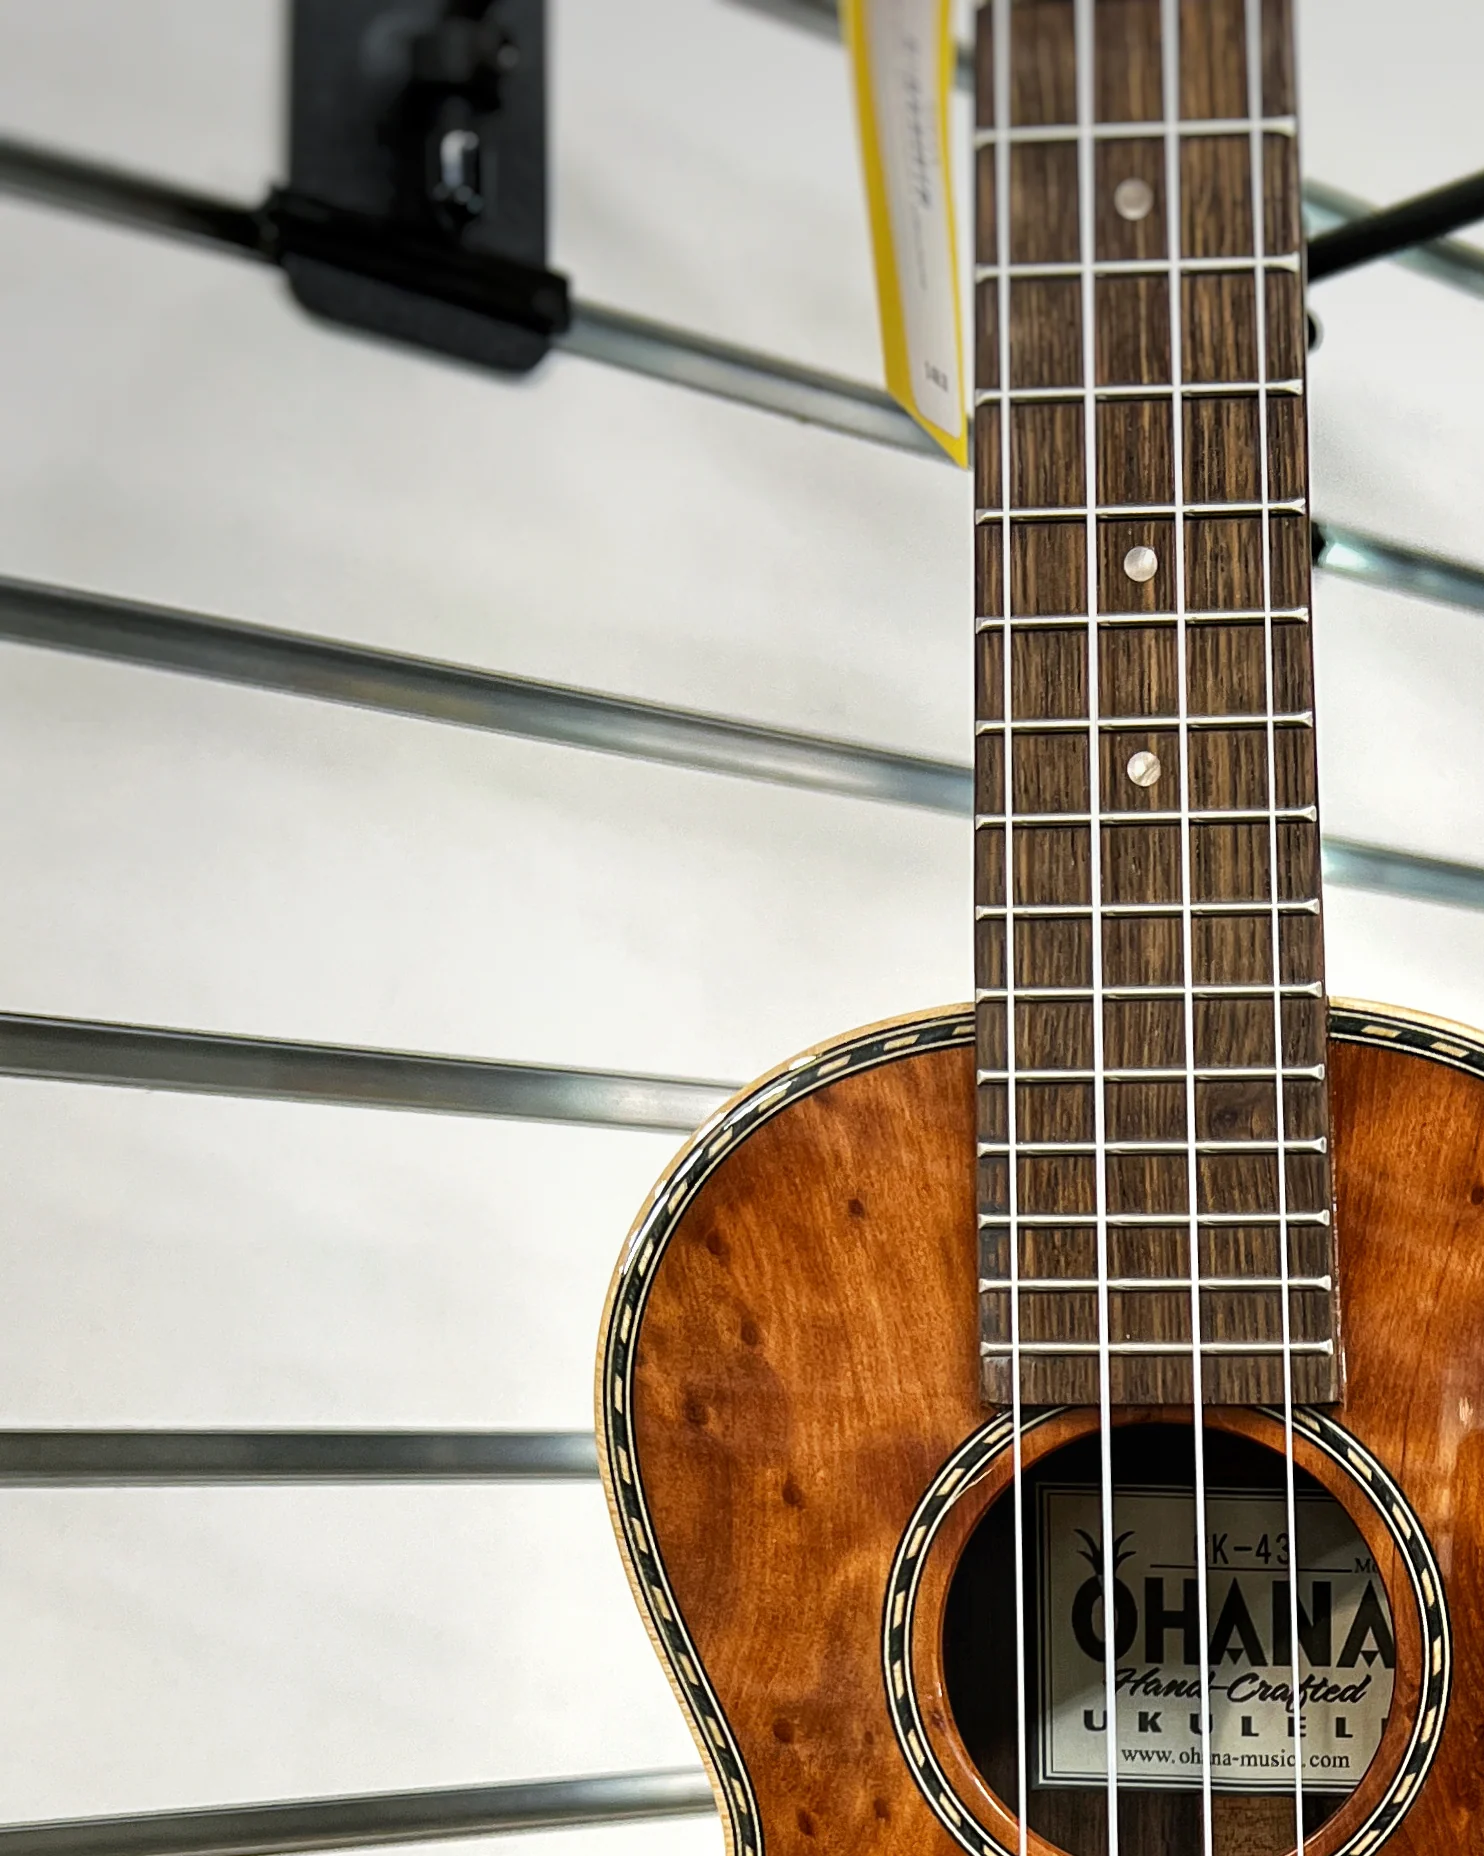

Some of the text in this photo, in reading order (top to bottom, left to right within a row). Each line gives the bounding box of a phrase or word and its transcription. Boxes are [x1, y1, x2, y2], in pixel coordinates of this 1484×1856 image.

[1195, 1533, 1290, 1565] K-43
[1072, 1575, 1394, 1669] OHANA
[1121, 1746, 1350, 1769] www.ohna-music.com
